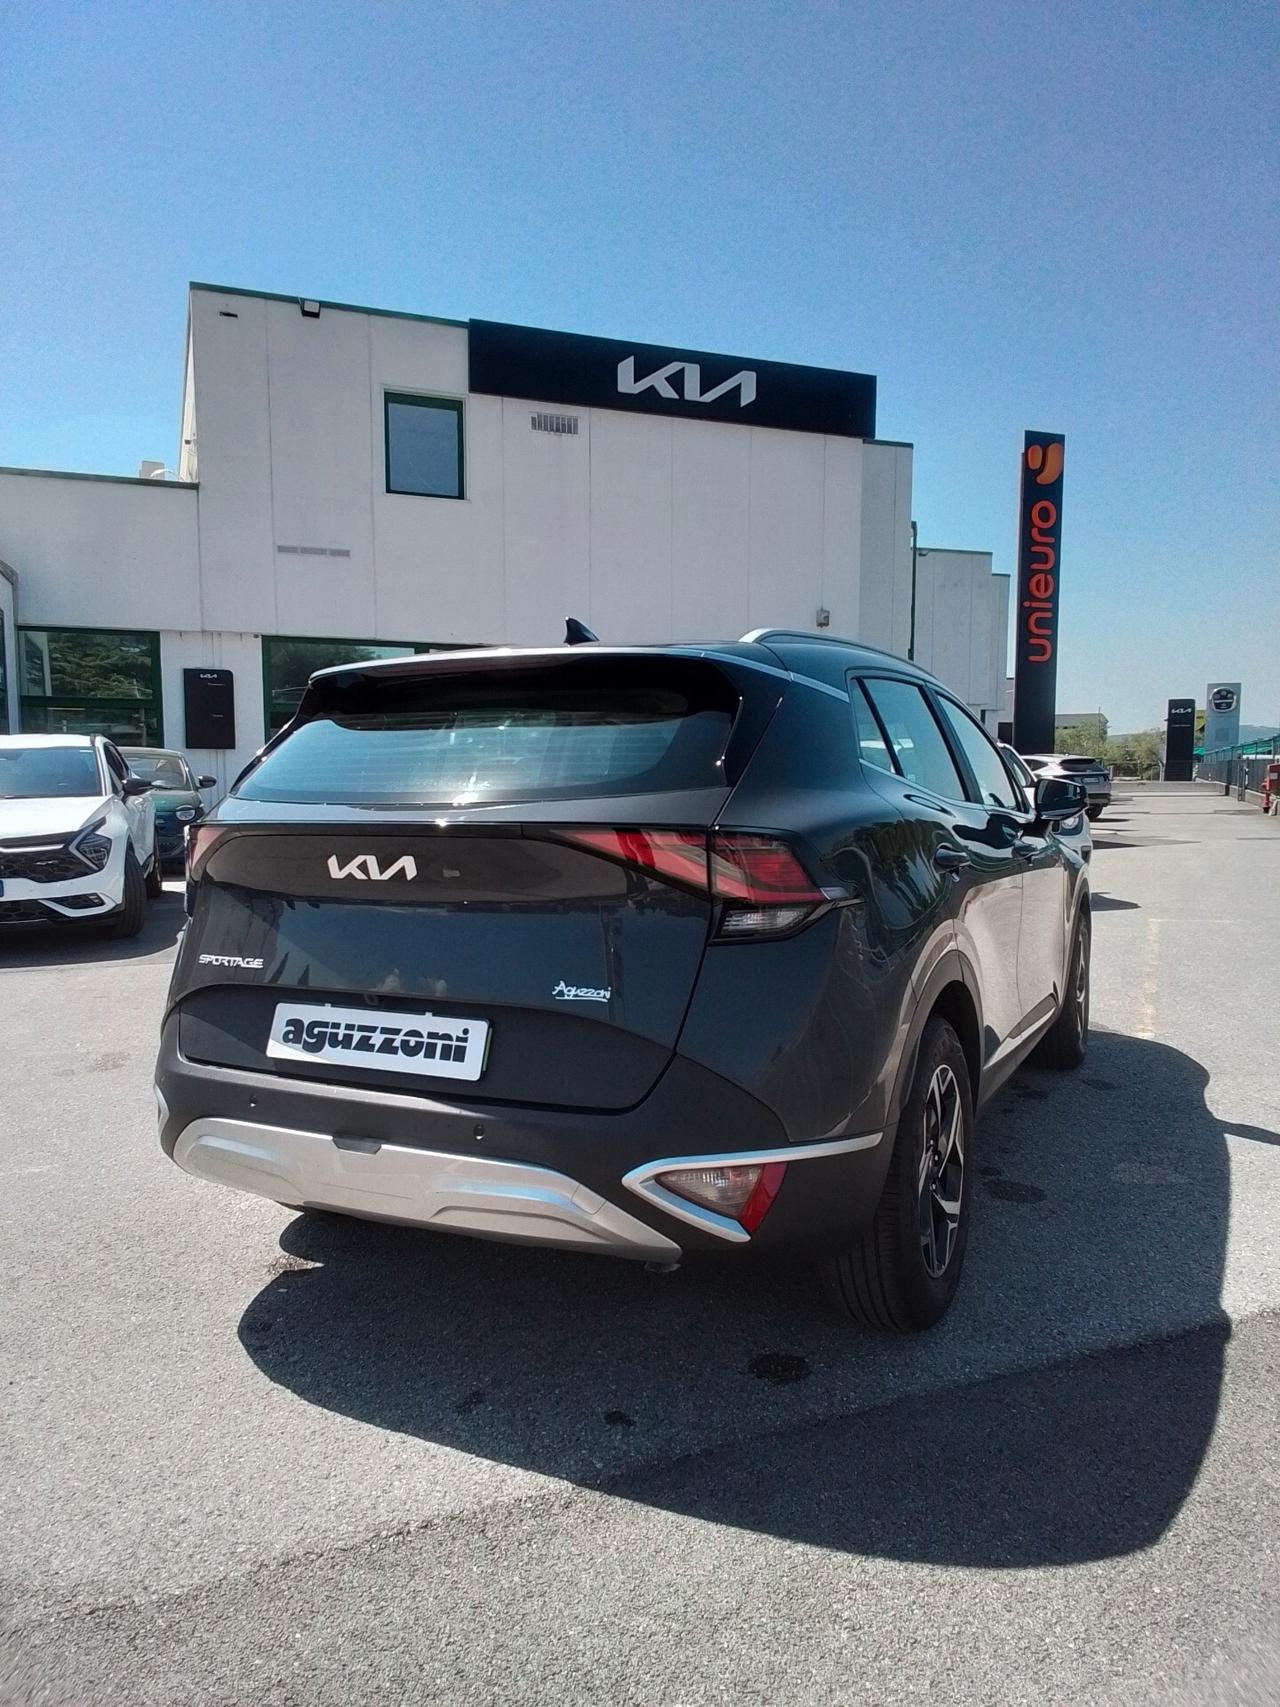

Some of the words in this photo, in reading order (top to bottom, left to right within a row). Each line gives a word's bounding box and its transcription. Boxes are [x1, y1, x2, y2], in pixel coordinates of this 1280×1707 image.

[617, 355, 757, 408] KIA
[1022, 500, 1057, 662] unieuro
[327, 854, 418, 881] KIA
[198, 954, 264, 969] SPORTAGE
[282, 1017, 470, 1063] aguzzoni
